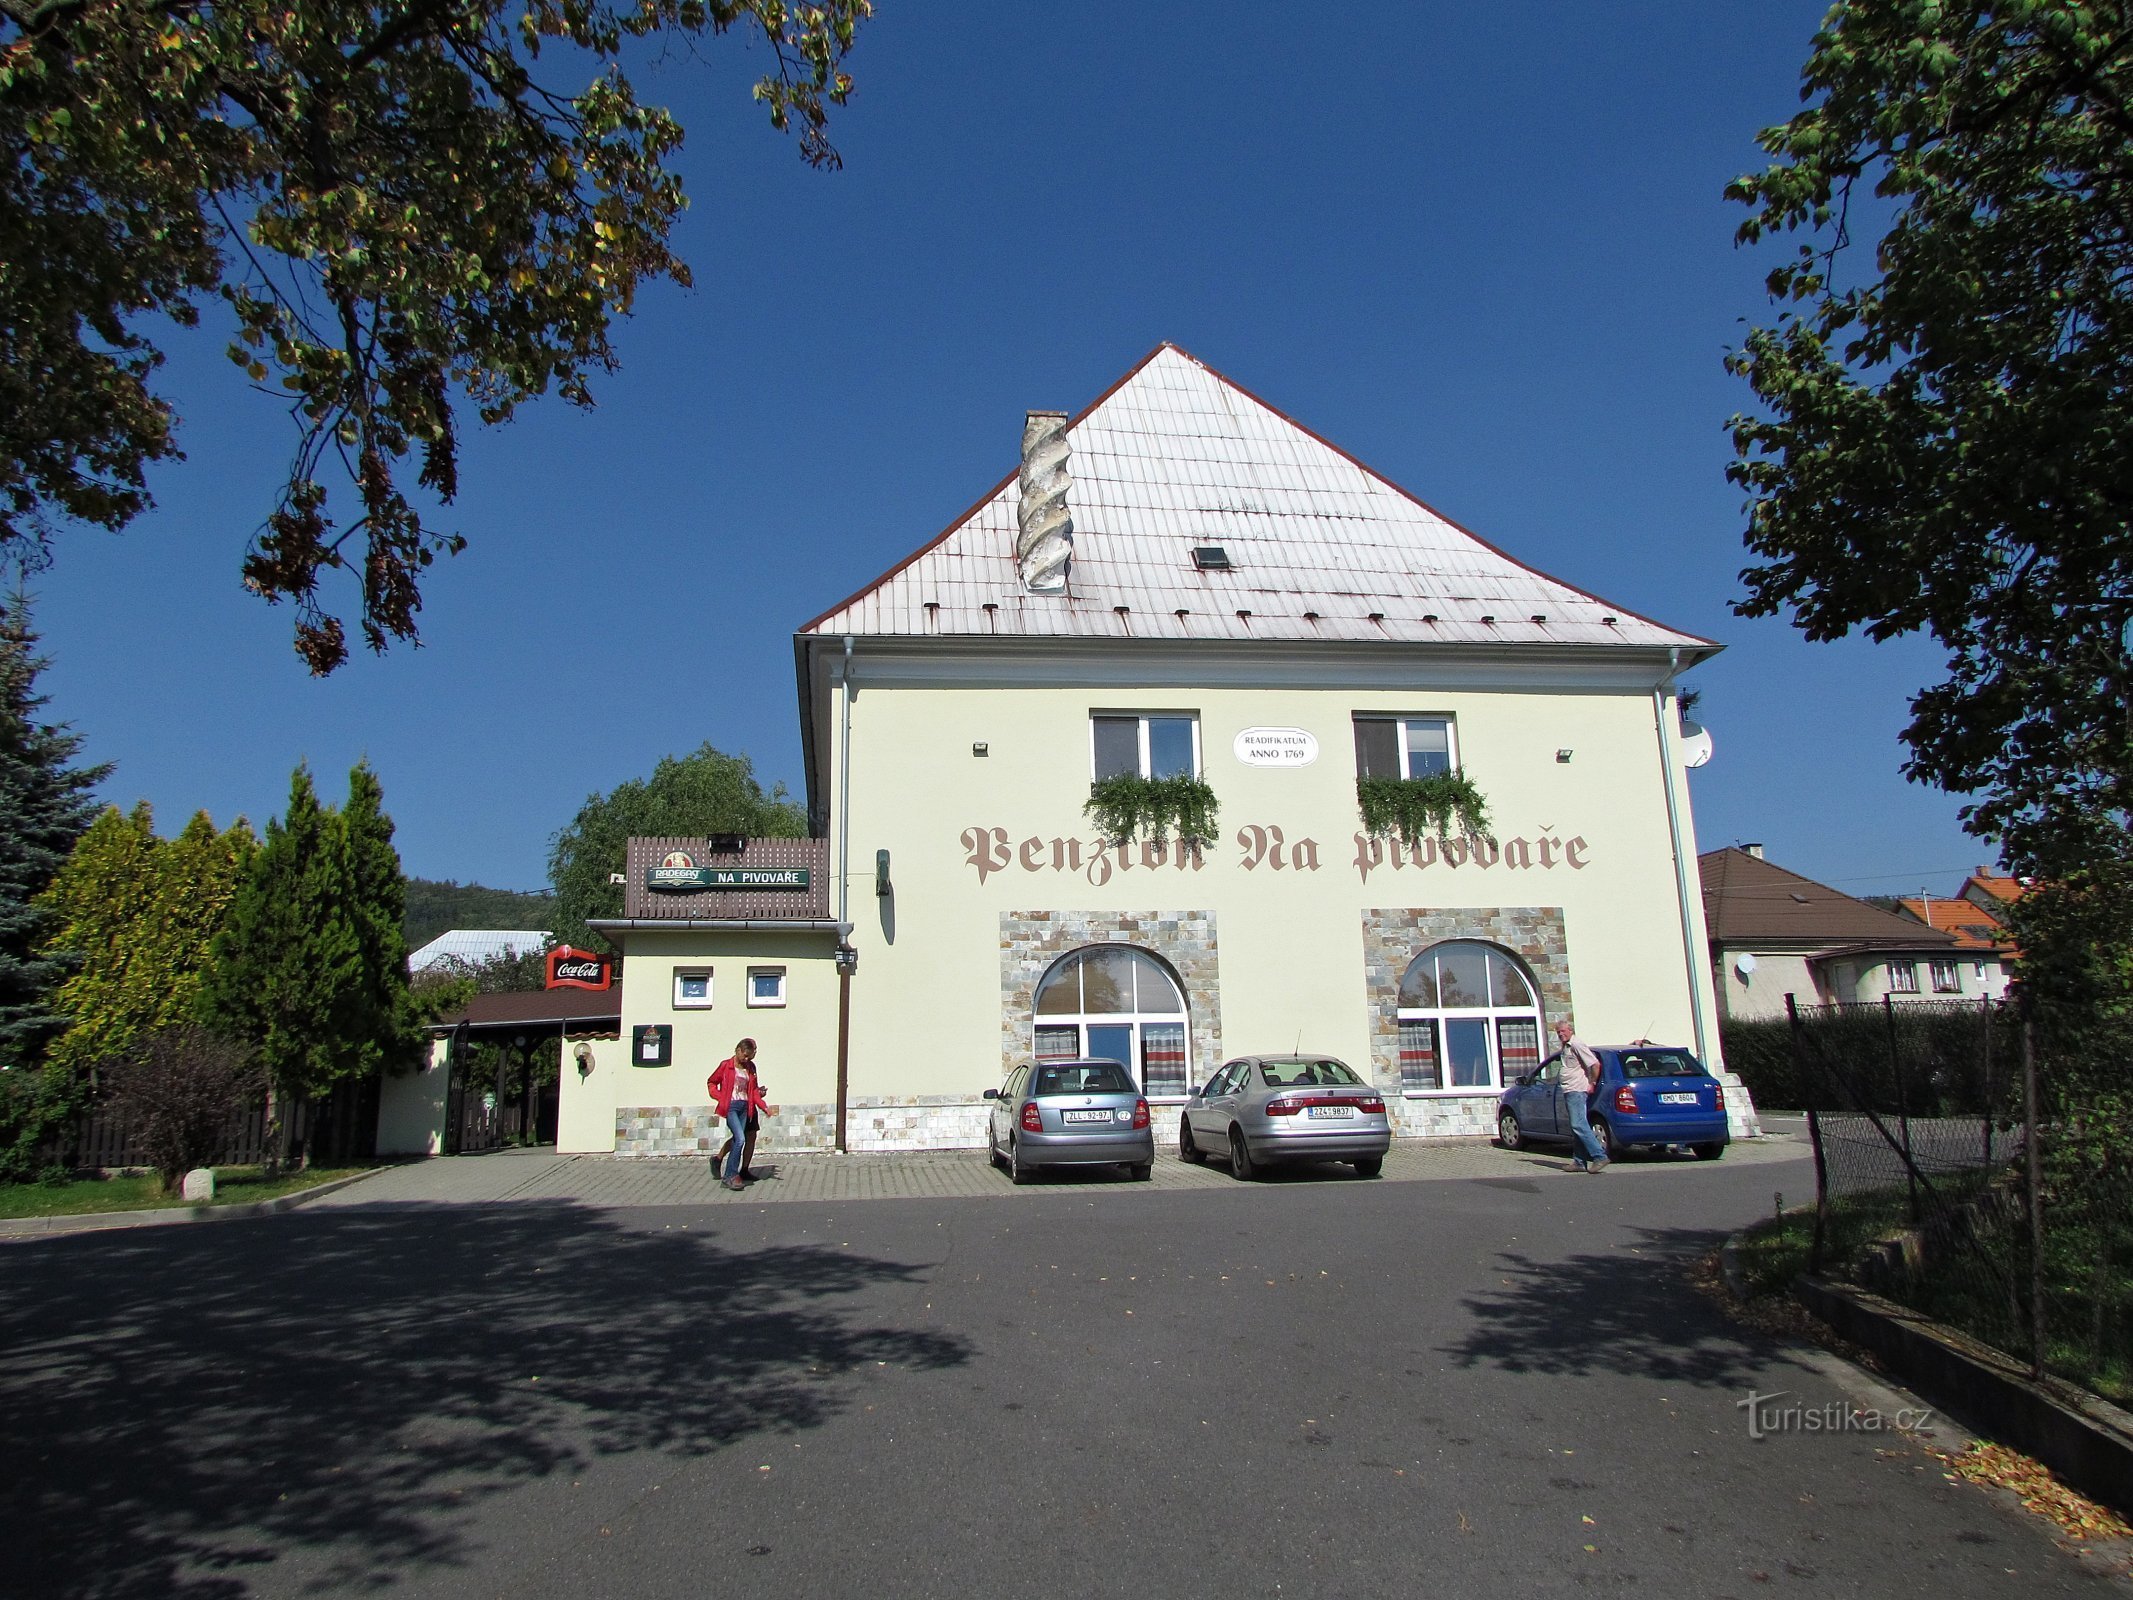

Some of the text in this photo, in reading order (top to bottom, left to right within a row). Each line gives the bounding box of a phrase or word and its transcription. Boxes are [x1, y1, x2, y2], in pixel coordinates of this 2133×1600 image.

[1245, 736, 1307, 745] READIFIKATUM
[1249, 749, 1305, 759] ANNO 1769
[960, 826, 1207, 887] Penzion
[1236, 824, 1324, 872] Na
[718, 870, 800, 883] NA PIVOVAŘE
[1314, 1107, 1349, 1115] 2Z4 9837
[1069, 1112, 1083, 1120] ZLL
[1120, 1112, 1129, 1120] CZ
